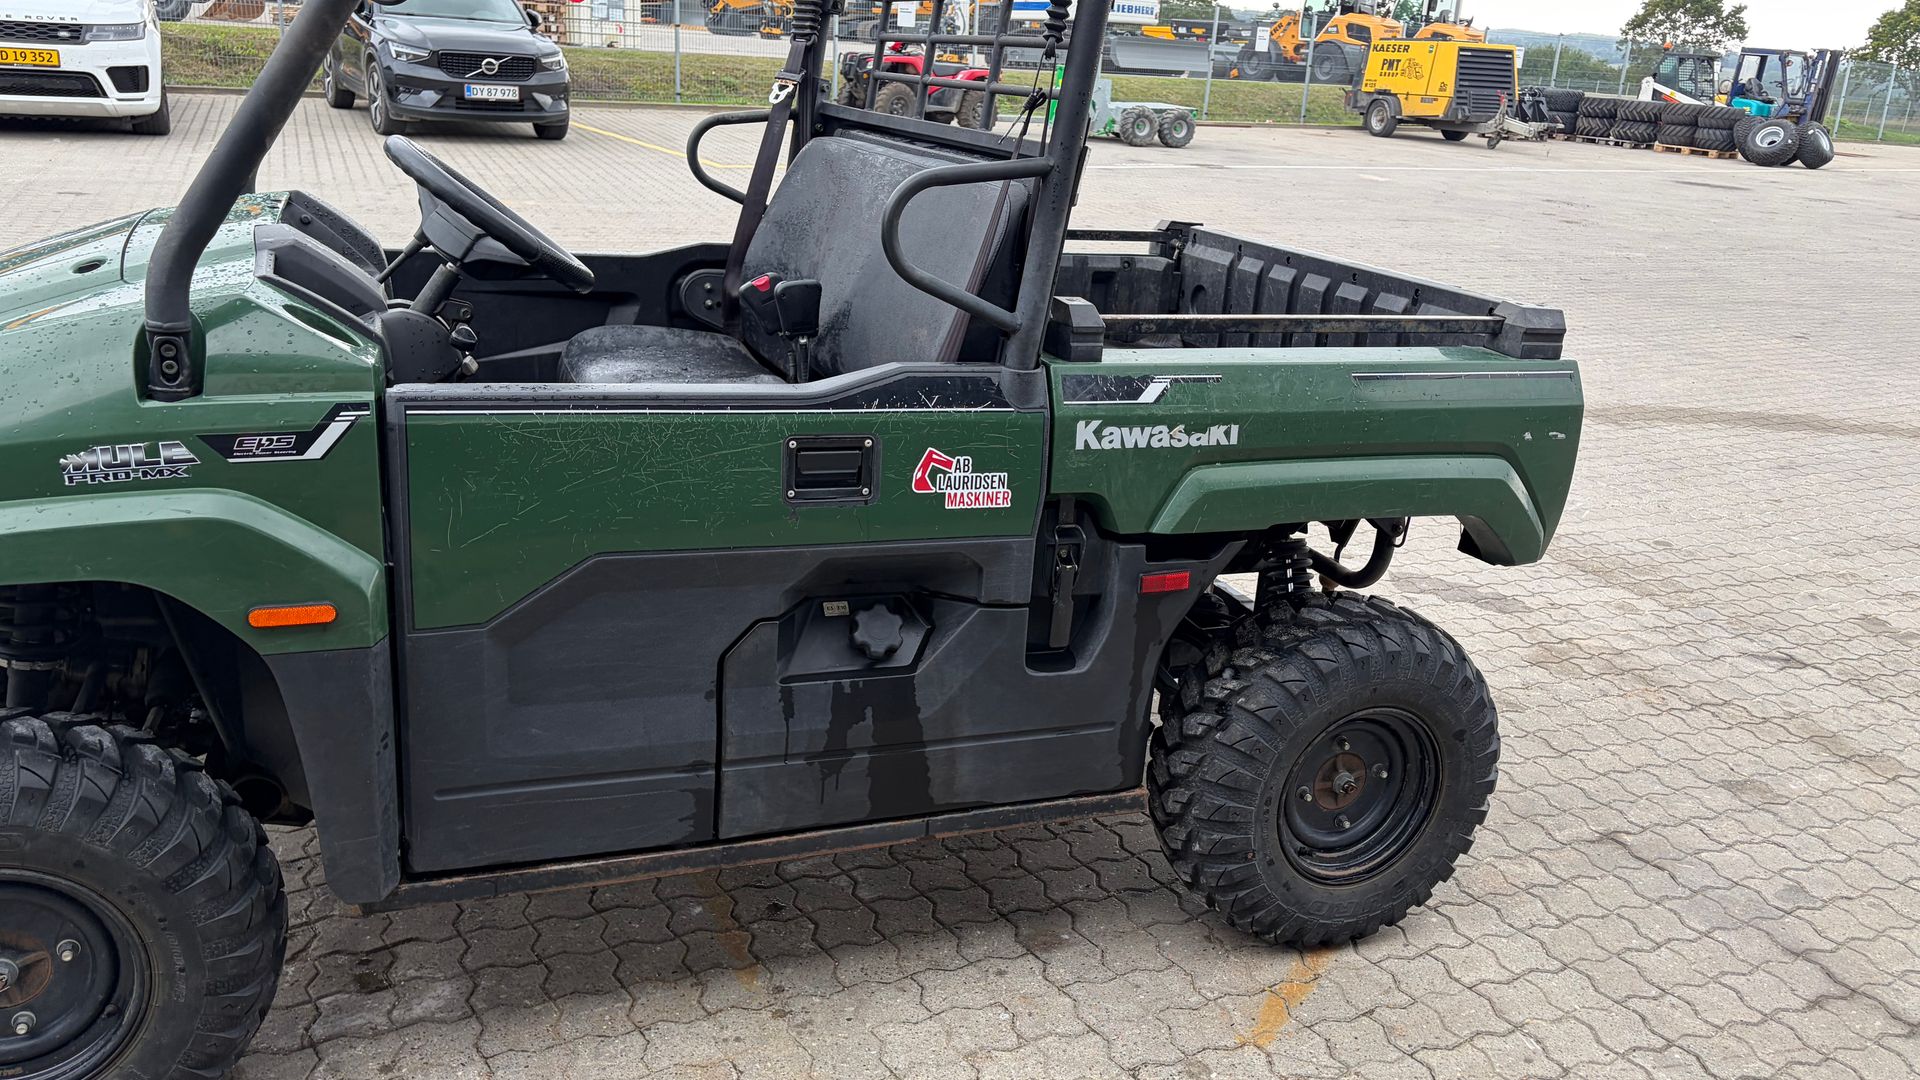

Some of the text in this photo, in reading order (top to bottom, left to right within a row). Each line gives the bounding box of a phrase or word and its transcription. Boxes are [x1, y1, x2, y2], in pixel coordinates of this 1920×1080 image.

[1372, 43, 1410, 53] KAESER
[13, 52, 27, 62] 19
[31, 52, 53, 63] 352
[1381, 58, 1401, 71] PMT
[472, 87, 518, 98] DY 87 978
[233, 435, 296, 452] EPS
[1075, 420, 1240, 450] Kawasaki
[58, 440, 201, 474] MULE
[954, 458, 971, 474] AB
[64, 465, 192, 486] PRO-MX
[938, 474, 1006, 491] LAURIDSEN
[946, 491, 1010, 508] MASKINER
